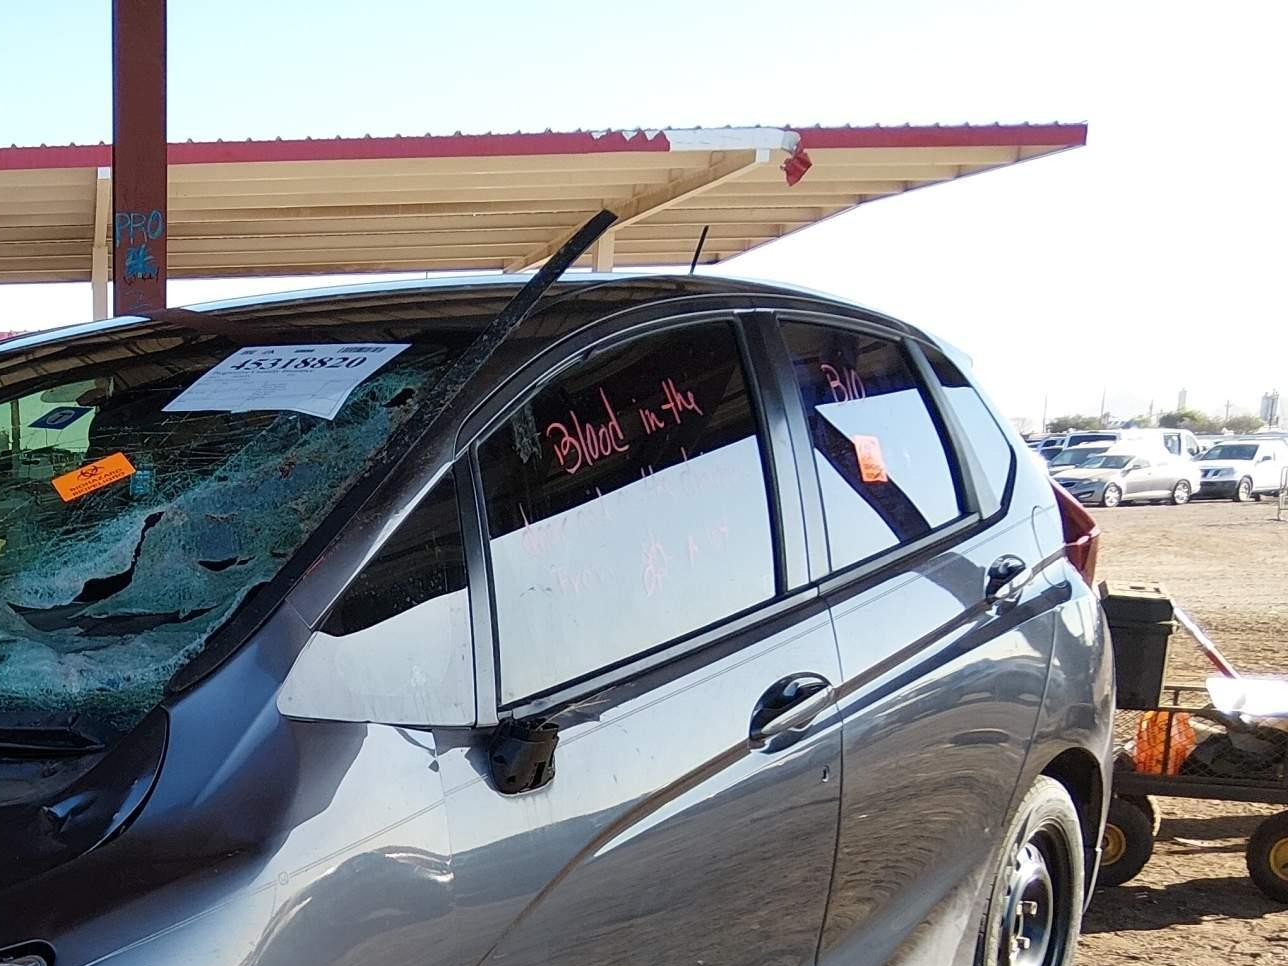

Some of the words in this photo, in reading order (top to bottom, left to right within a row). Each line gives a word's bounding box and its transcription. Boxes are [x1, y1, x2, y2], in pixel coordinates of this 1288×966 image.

[115, 210, 164, 248] PRO
[230, 356, 367, 371] 45318820
[546, 386, 630, 474] Blood
[639, 408, 665, 434] in
